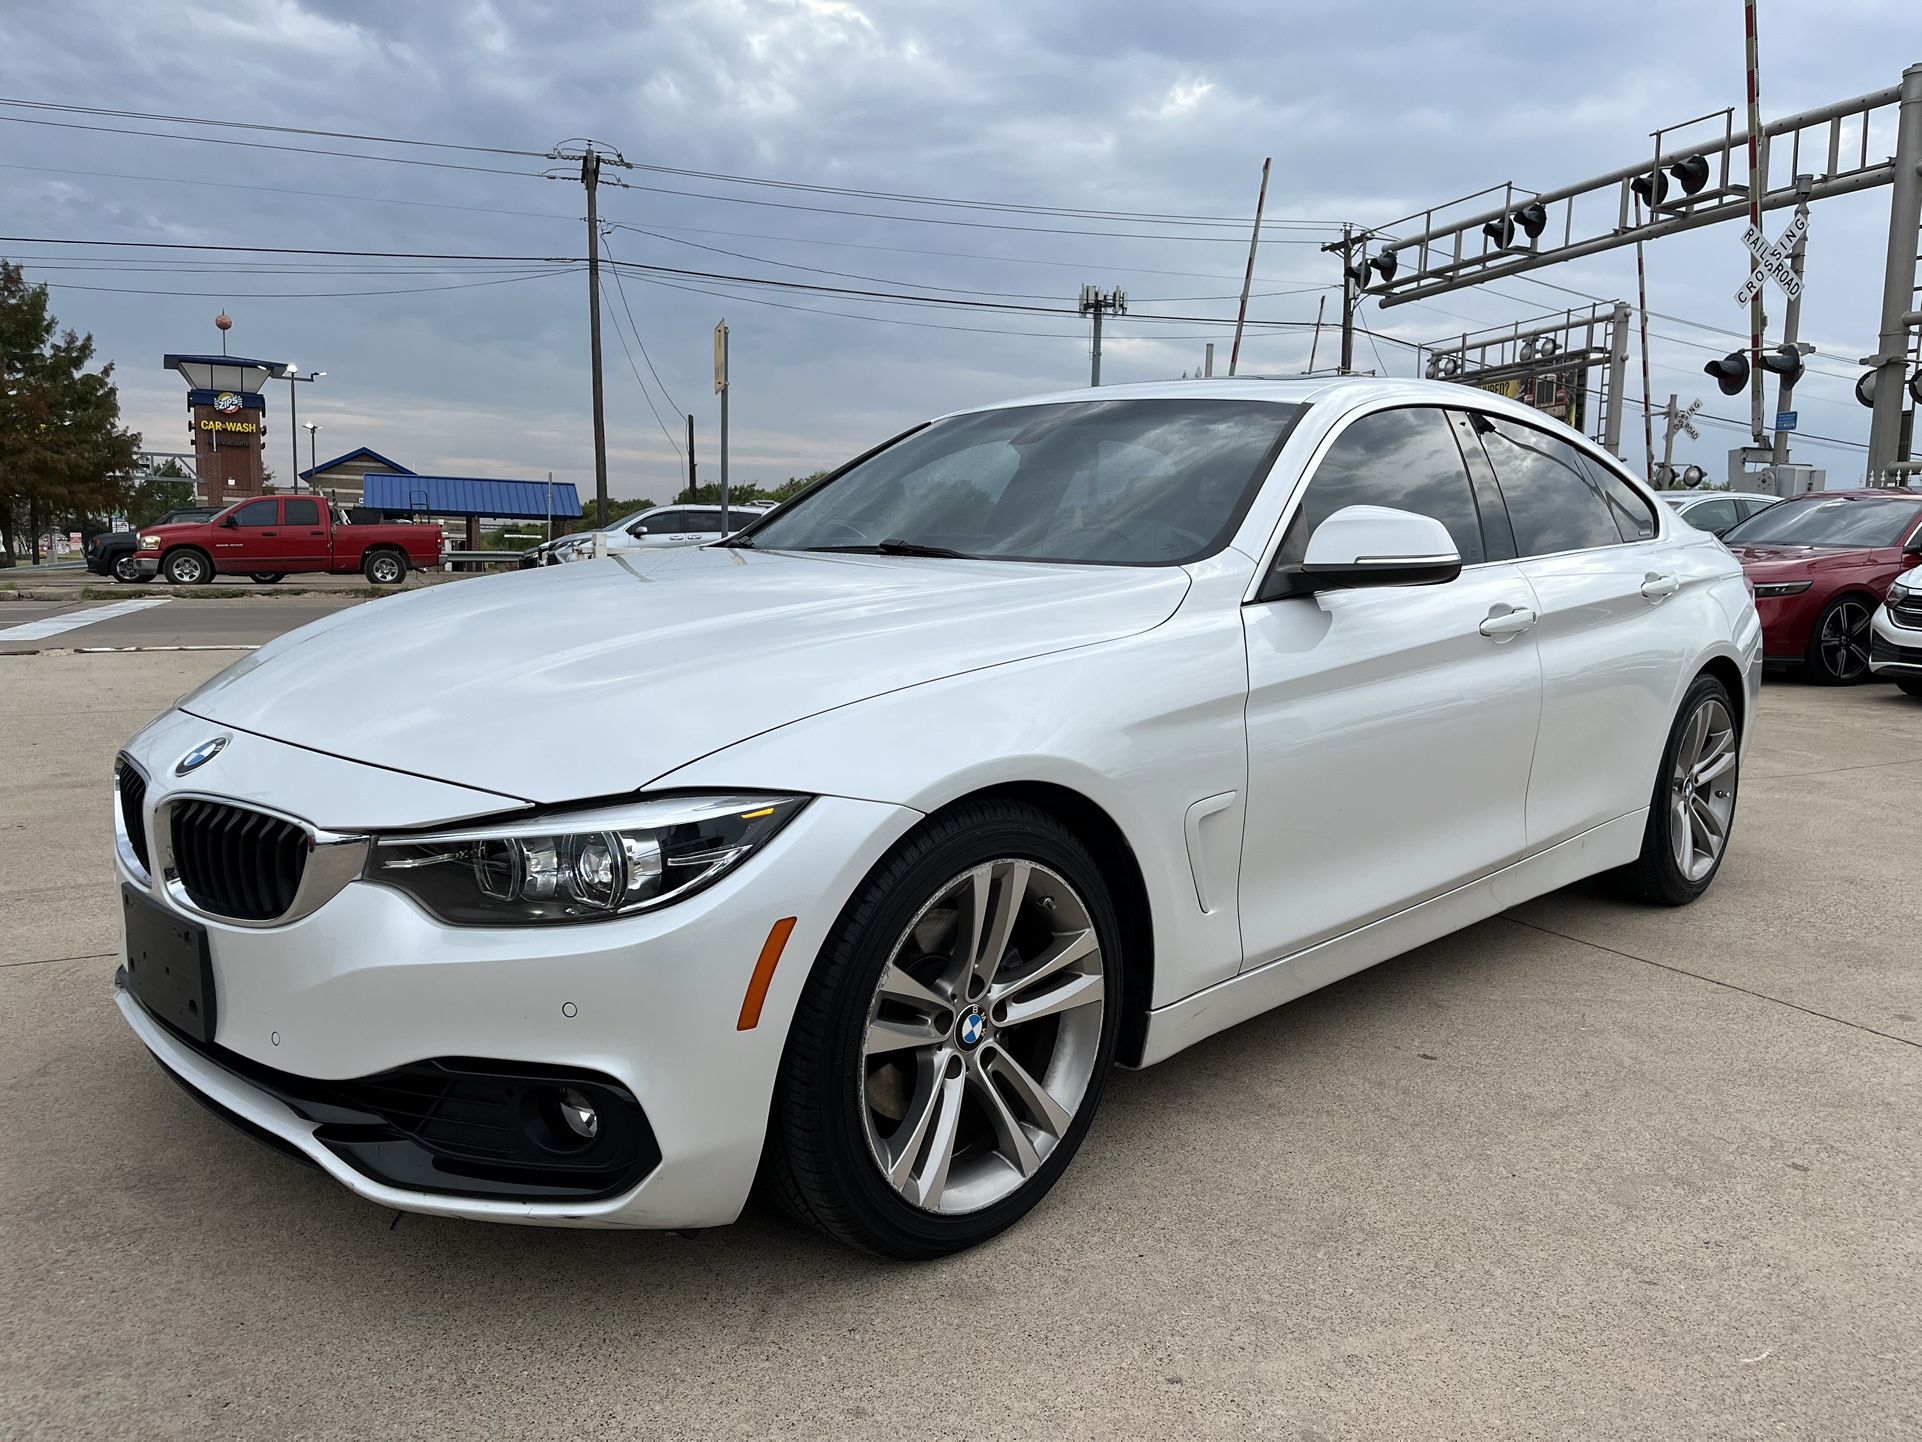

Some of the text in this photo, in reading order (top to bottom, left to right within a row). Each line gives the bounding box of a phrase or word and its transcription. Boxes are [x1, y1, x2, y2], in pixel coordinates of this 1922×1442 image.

[1738, 218, 1805, 304] CROSSING
[1744, 228, 1800, 296] RAIL ROAD
[218, 396, 238, 410] ZIPS
[200, 420, 256, 433] CAR WASH
